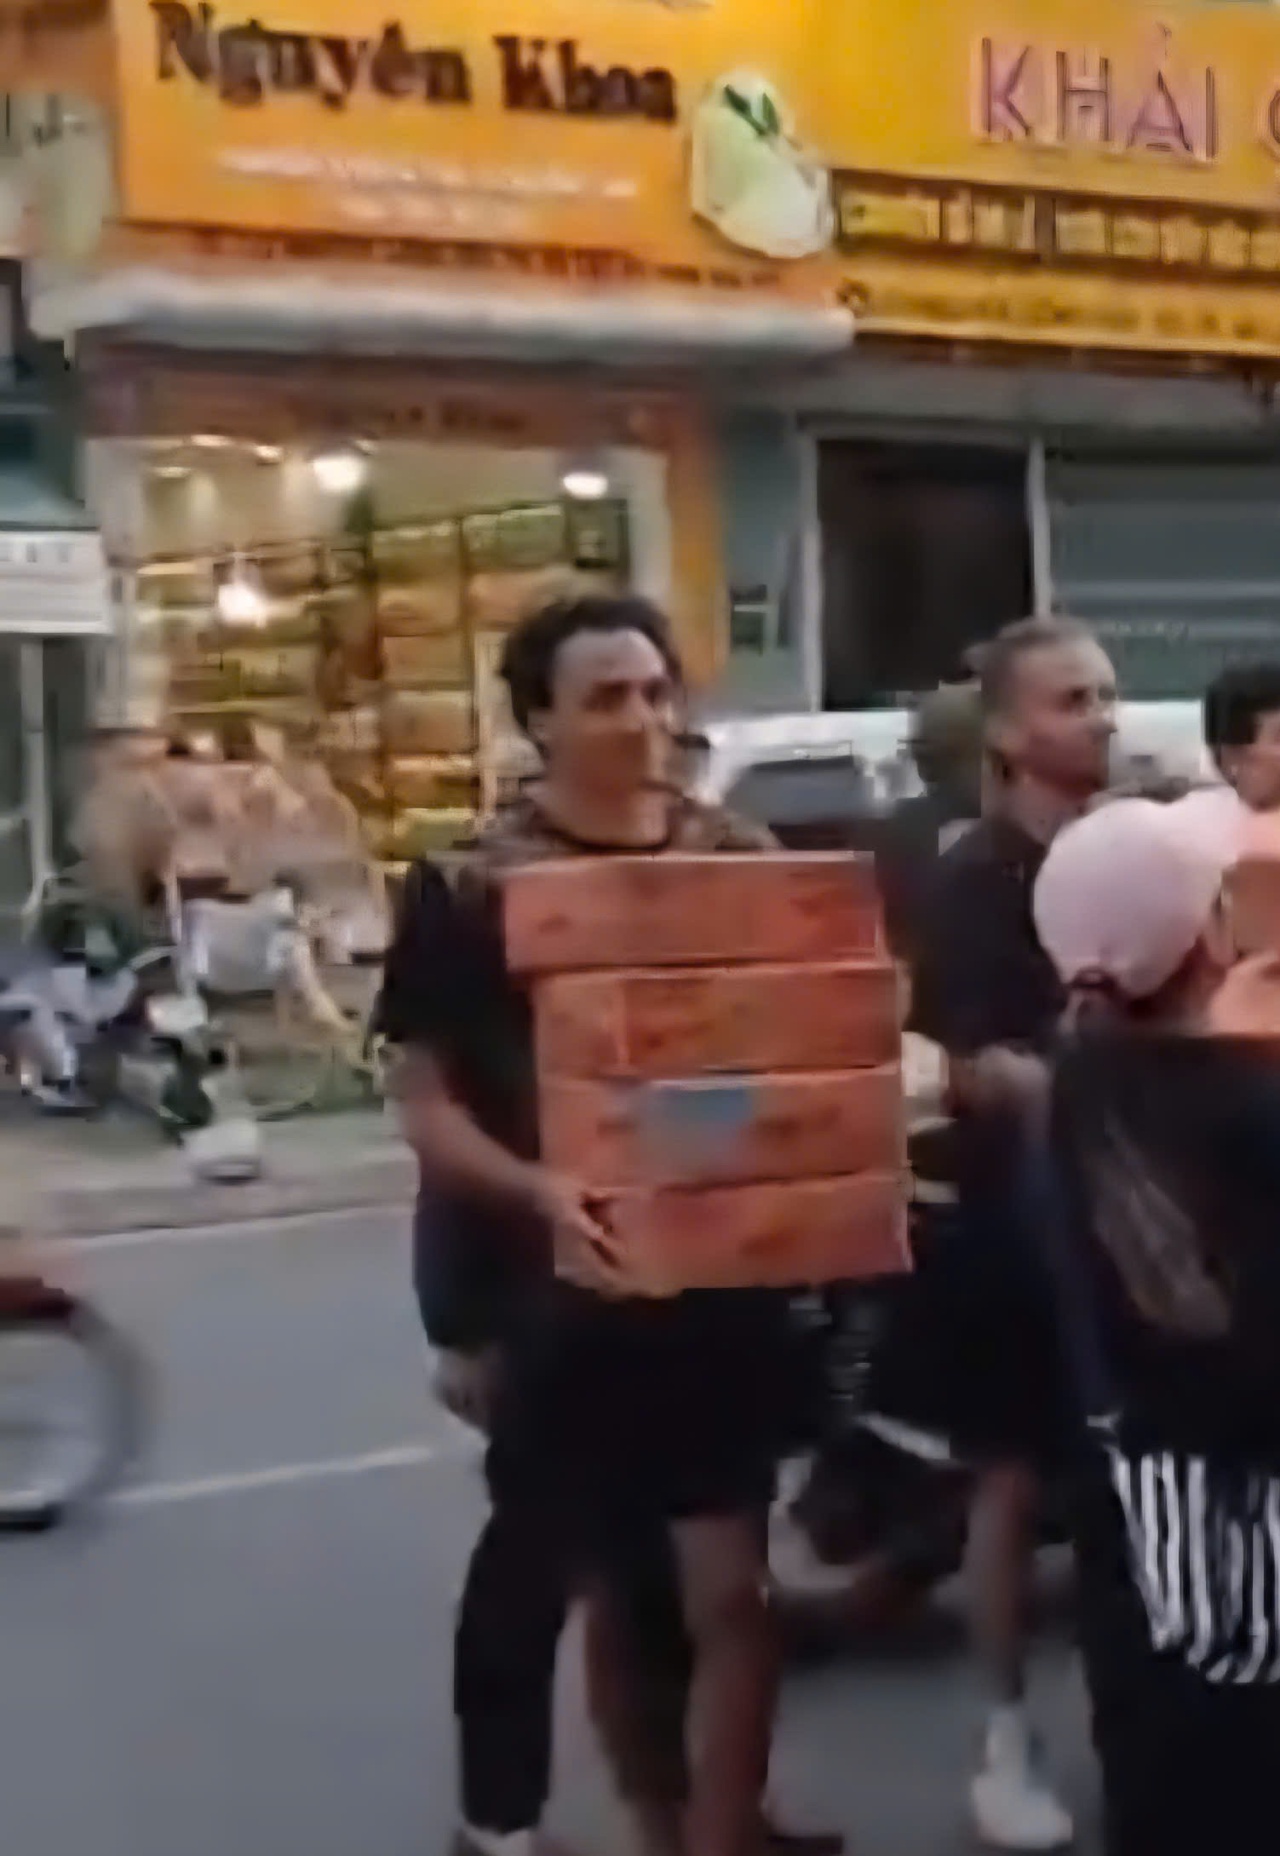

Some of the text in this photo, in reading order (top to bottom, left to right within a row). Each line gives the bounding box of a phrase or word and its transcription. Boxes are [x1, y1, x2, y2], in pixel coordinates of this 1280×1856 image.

[150, 1, 677, 123] Nguyên Khoa
[974, 20, 1220, 164] KHẢI
